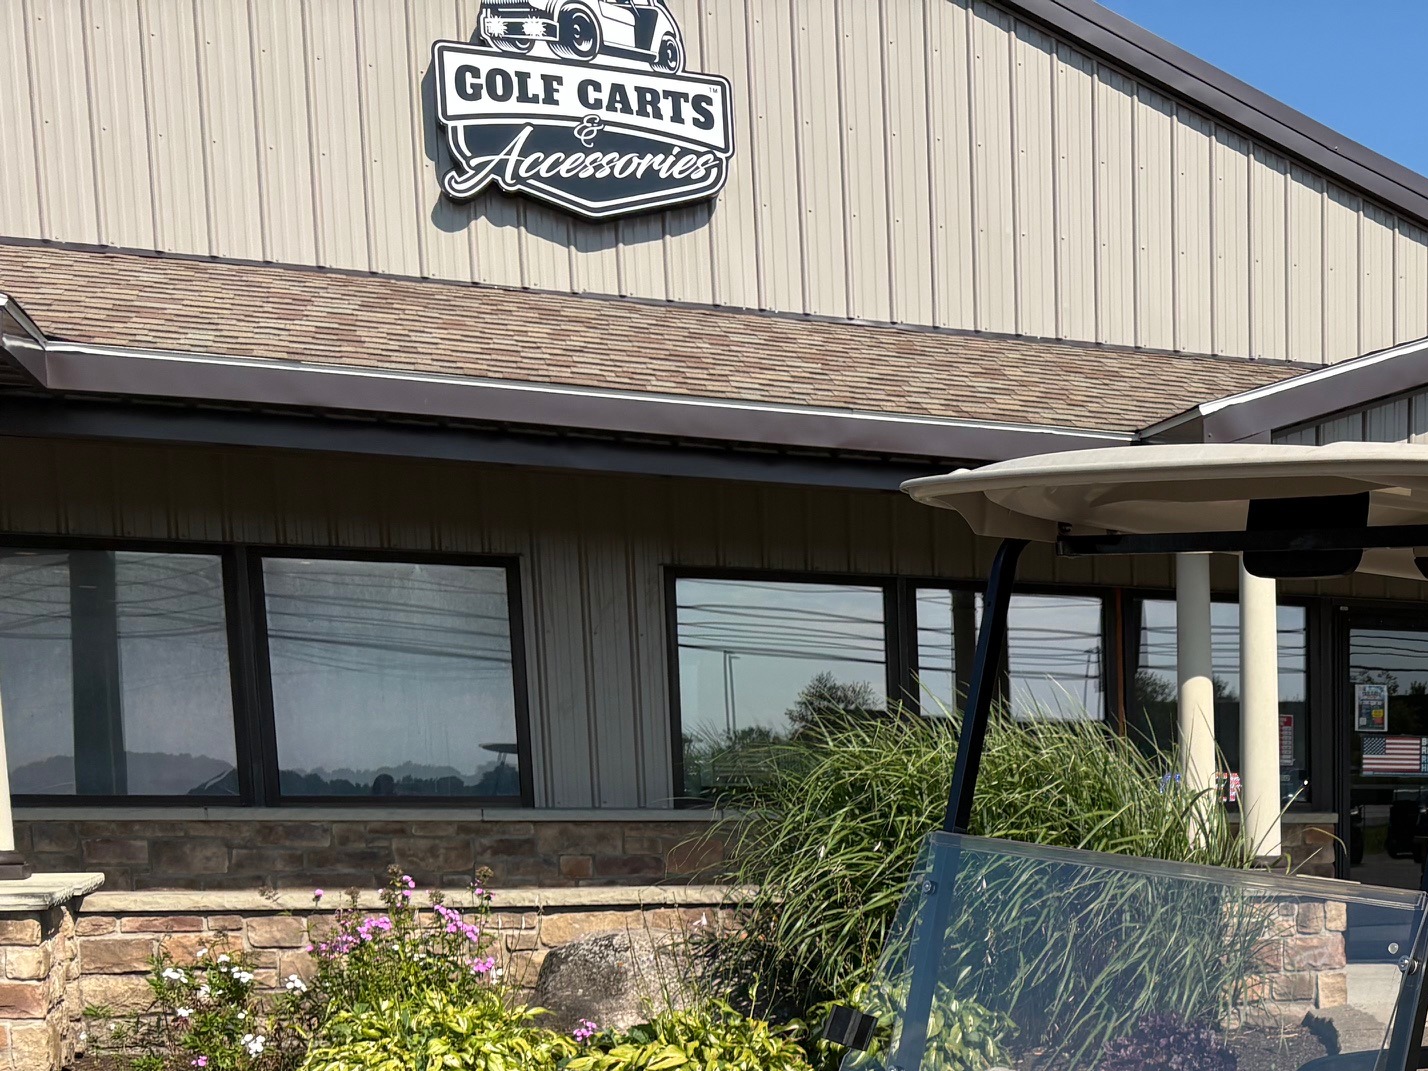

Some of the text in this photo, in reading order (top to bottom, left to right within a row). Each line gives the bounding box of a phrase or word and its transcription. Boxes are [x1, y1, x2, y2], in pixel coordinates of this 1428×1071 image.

[454, 64, 715, 131] GOLF CARTS
[451, 125, 720, 190] Accessories
[573, 114, 604, 148] &
